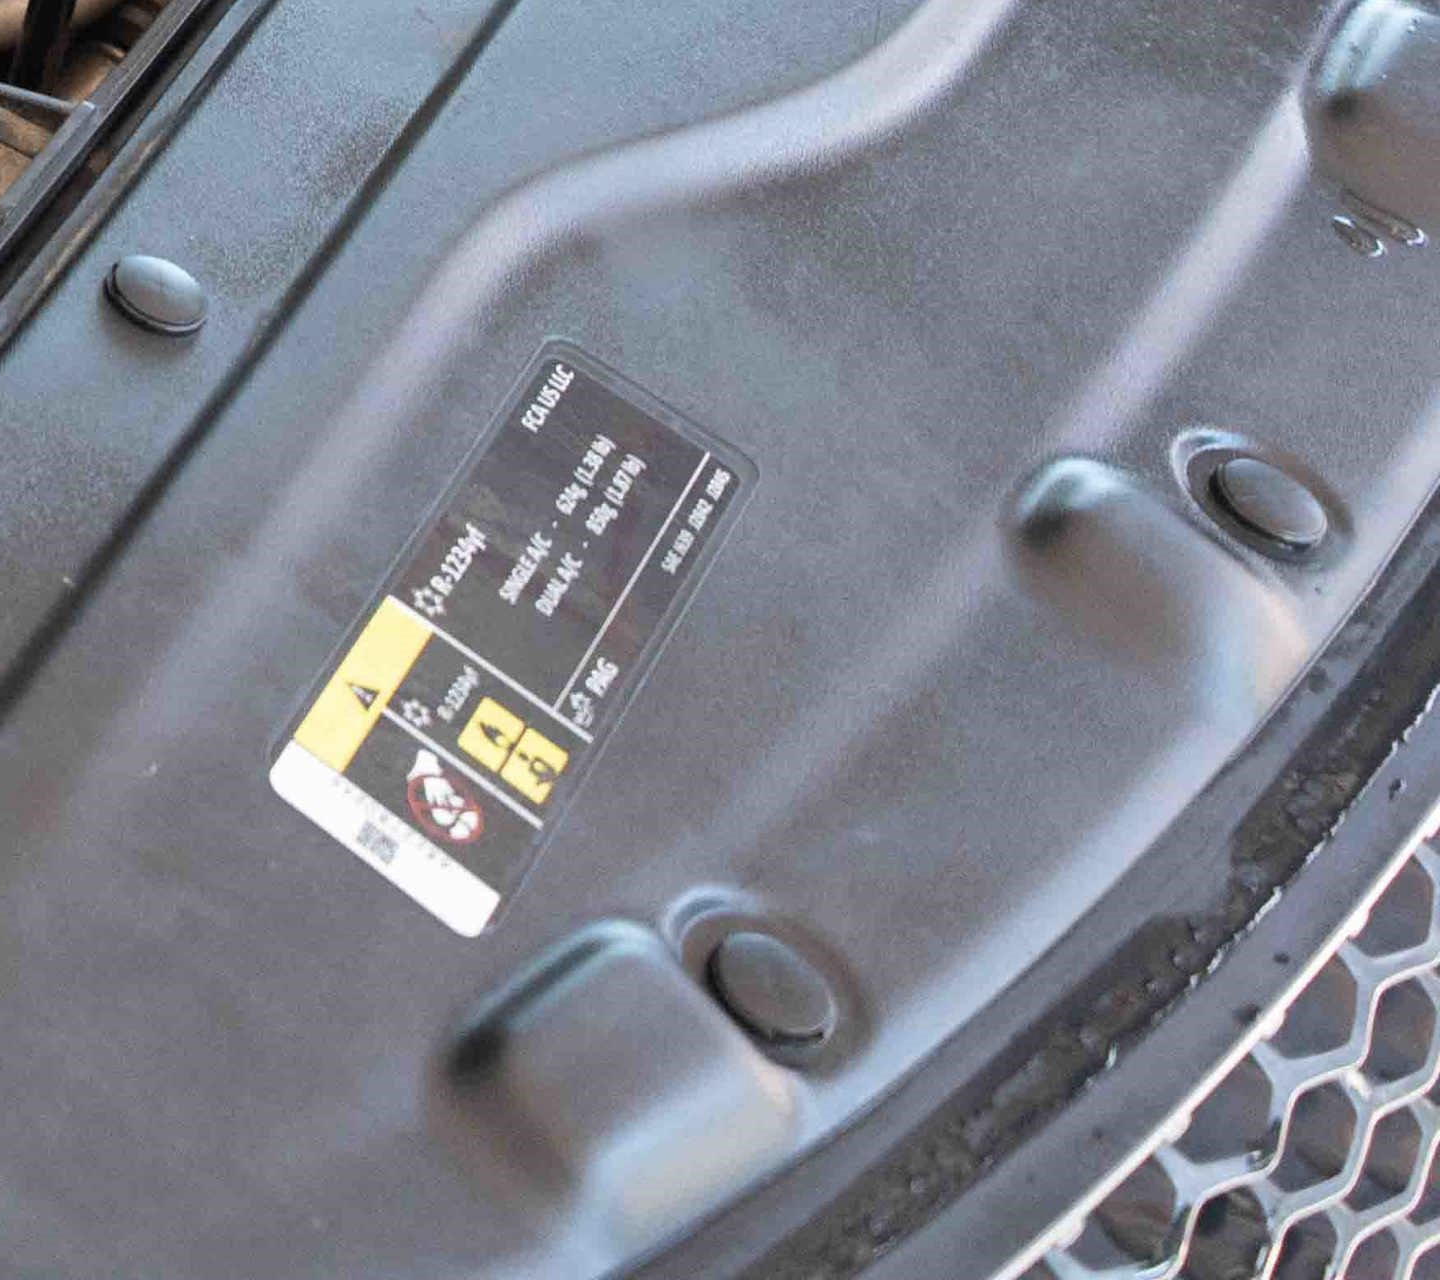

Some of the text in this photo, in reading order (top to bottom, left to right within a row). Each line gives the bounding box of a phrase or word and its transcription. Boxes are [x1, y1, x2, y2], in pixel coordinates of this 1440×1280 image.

[520, 363, 575, 433] FCA US LLC
[430, 521, 487, 595] R-1234yf
[499, 554, 538, 605] SINGLE
[525, 531, 552, 564] A/C
[535, 576, 568, 616] DUAL
[556, 551, 583, 579] A/C
[585, 657, 620, 698] PAG
